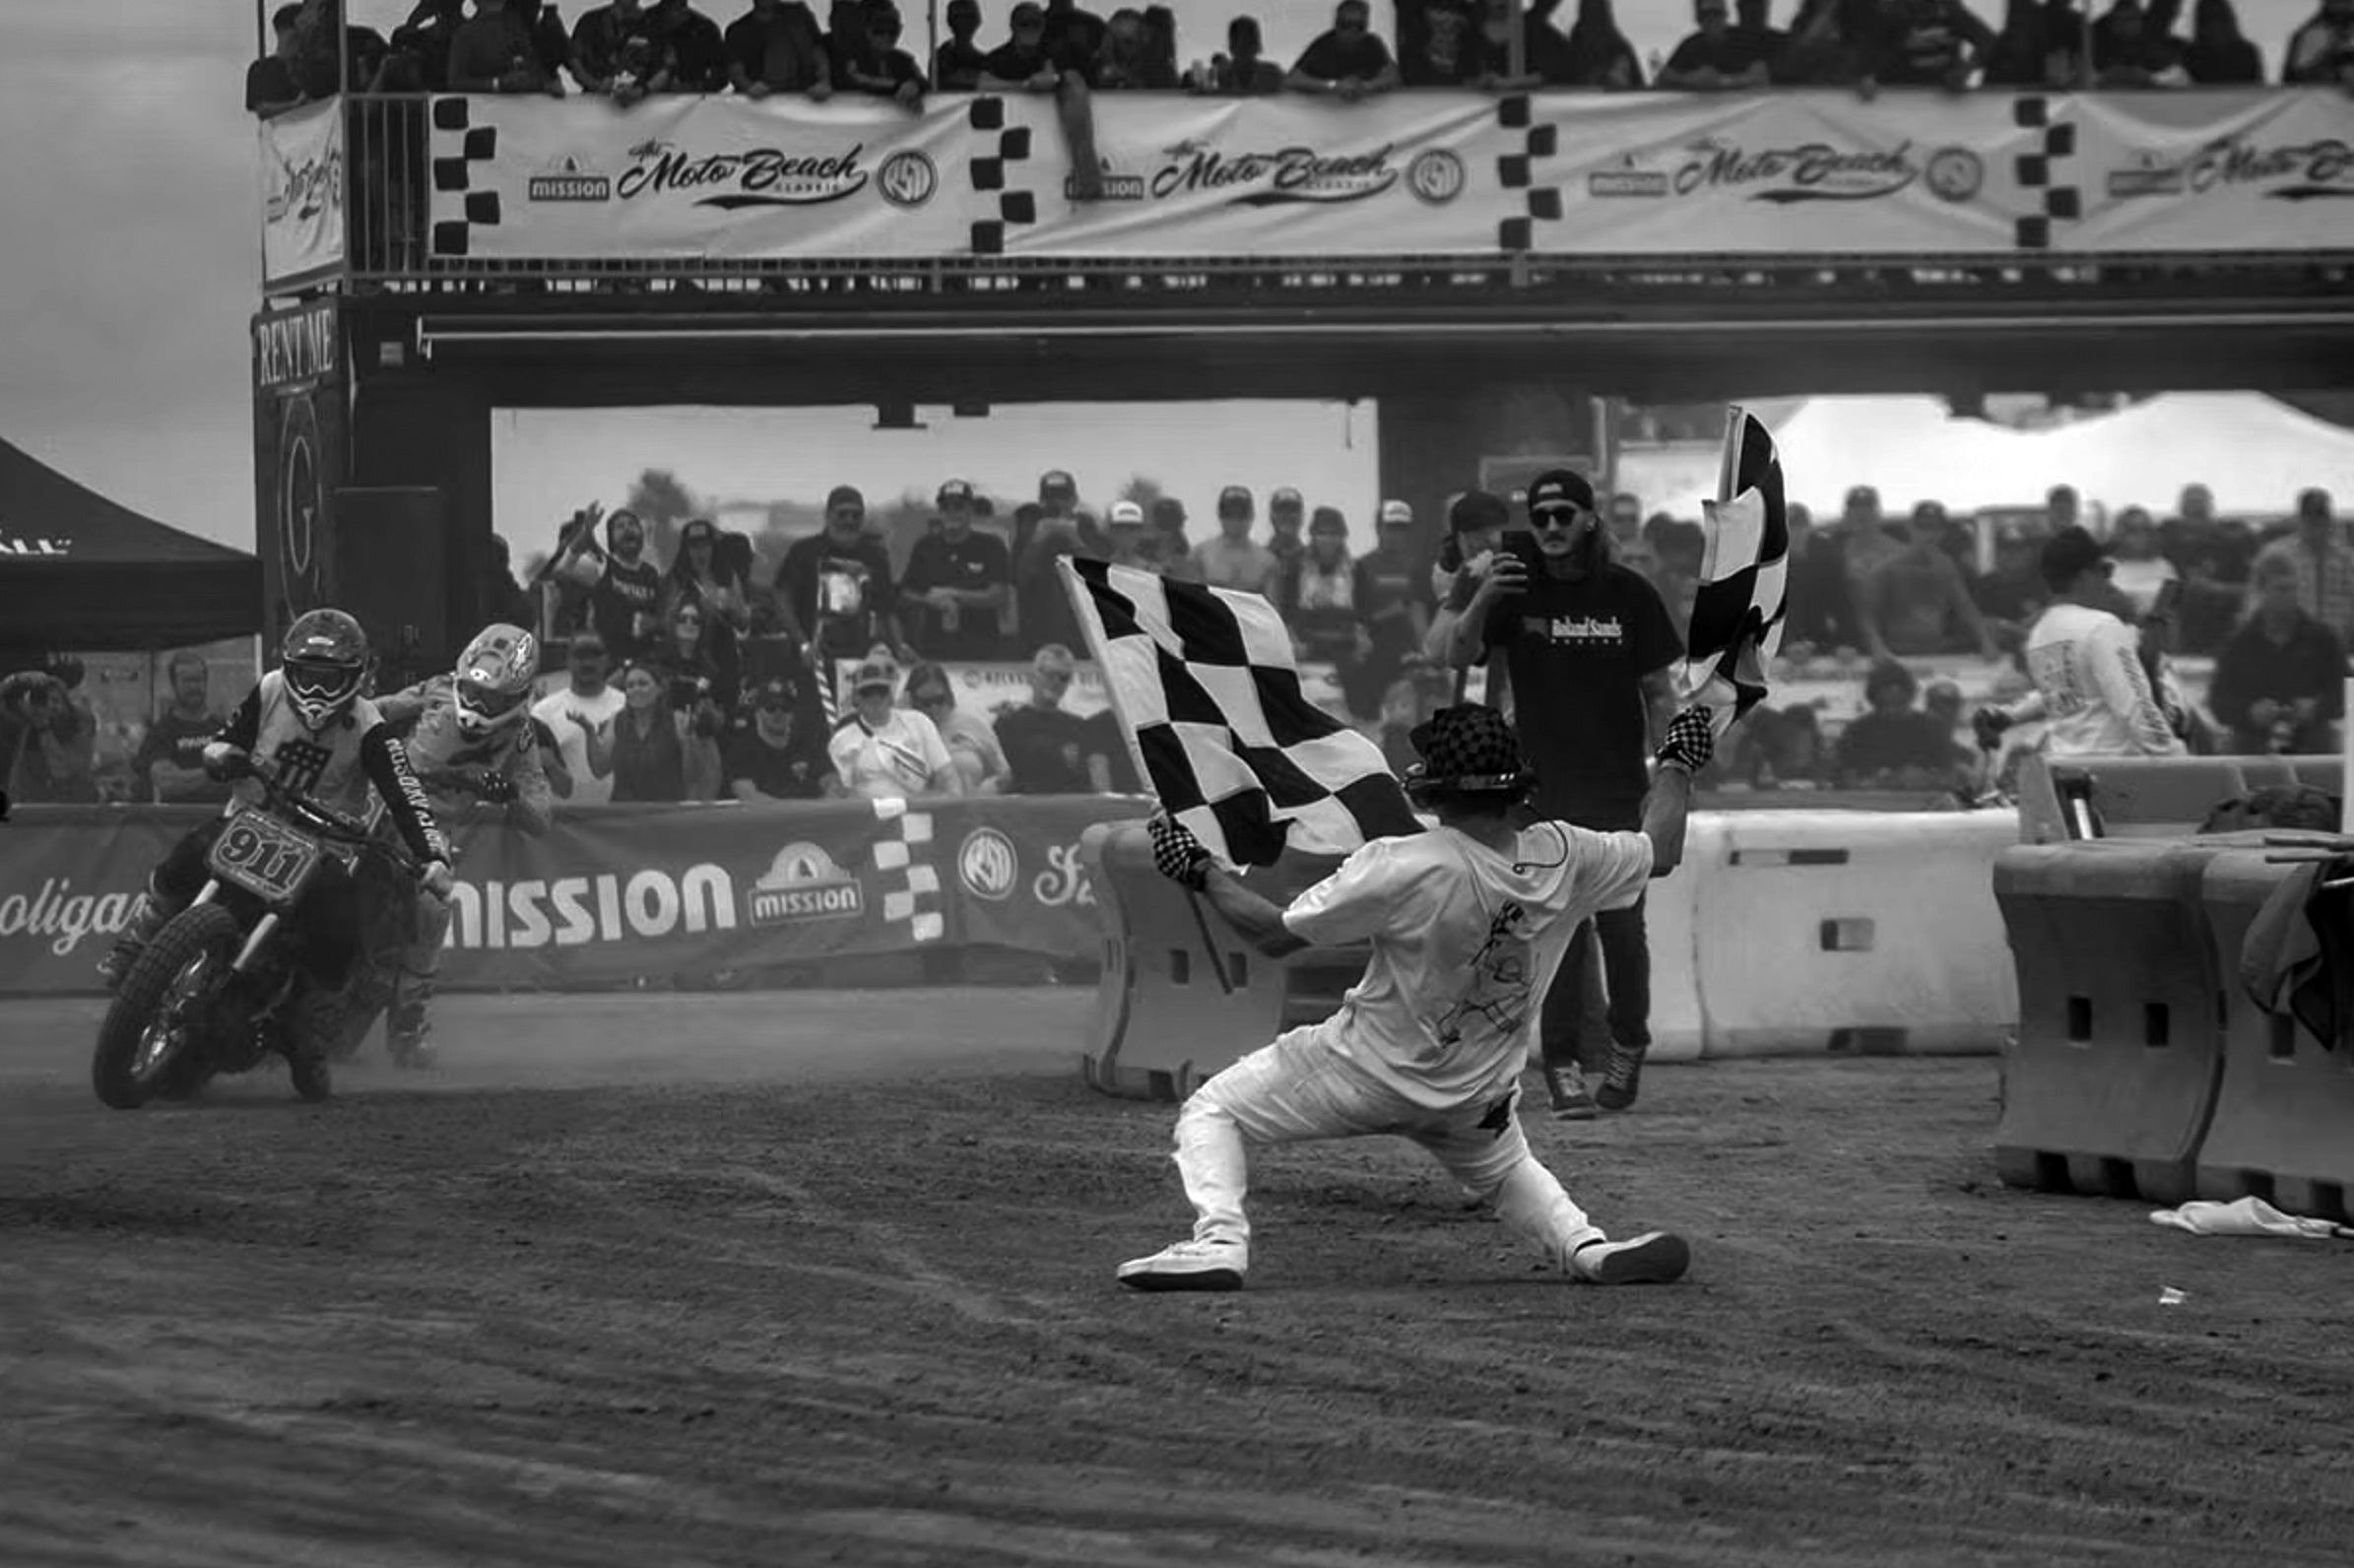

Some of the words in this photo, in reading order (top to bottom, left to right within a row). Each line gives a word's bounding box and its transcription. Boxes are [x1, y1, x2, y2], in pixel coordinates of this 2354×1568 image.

[617, 152, 741, 199] Moto
[741, 143, 865, 191] Beach
[1152, 152, 1275, 199] Moto
[1274, 143, 1395, 189] Beach
[260, 315, 303, 386] RENT
[307, 309, 333, 375] ME
[218, 824, 306, 893] 911
